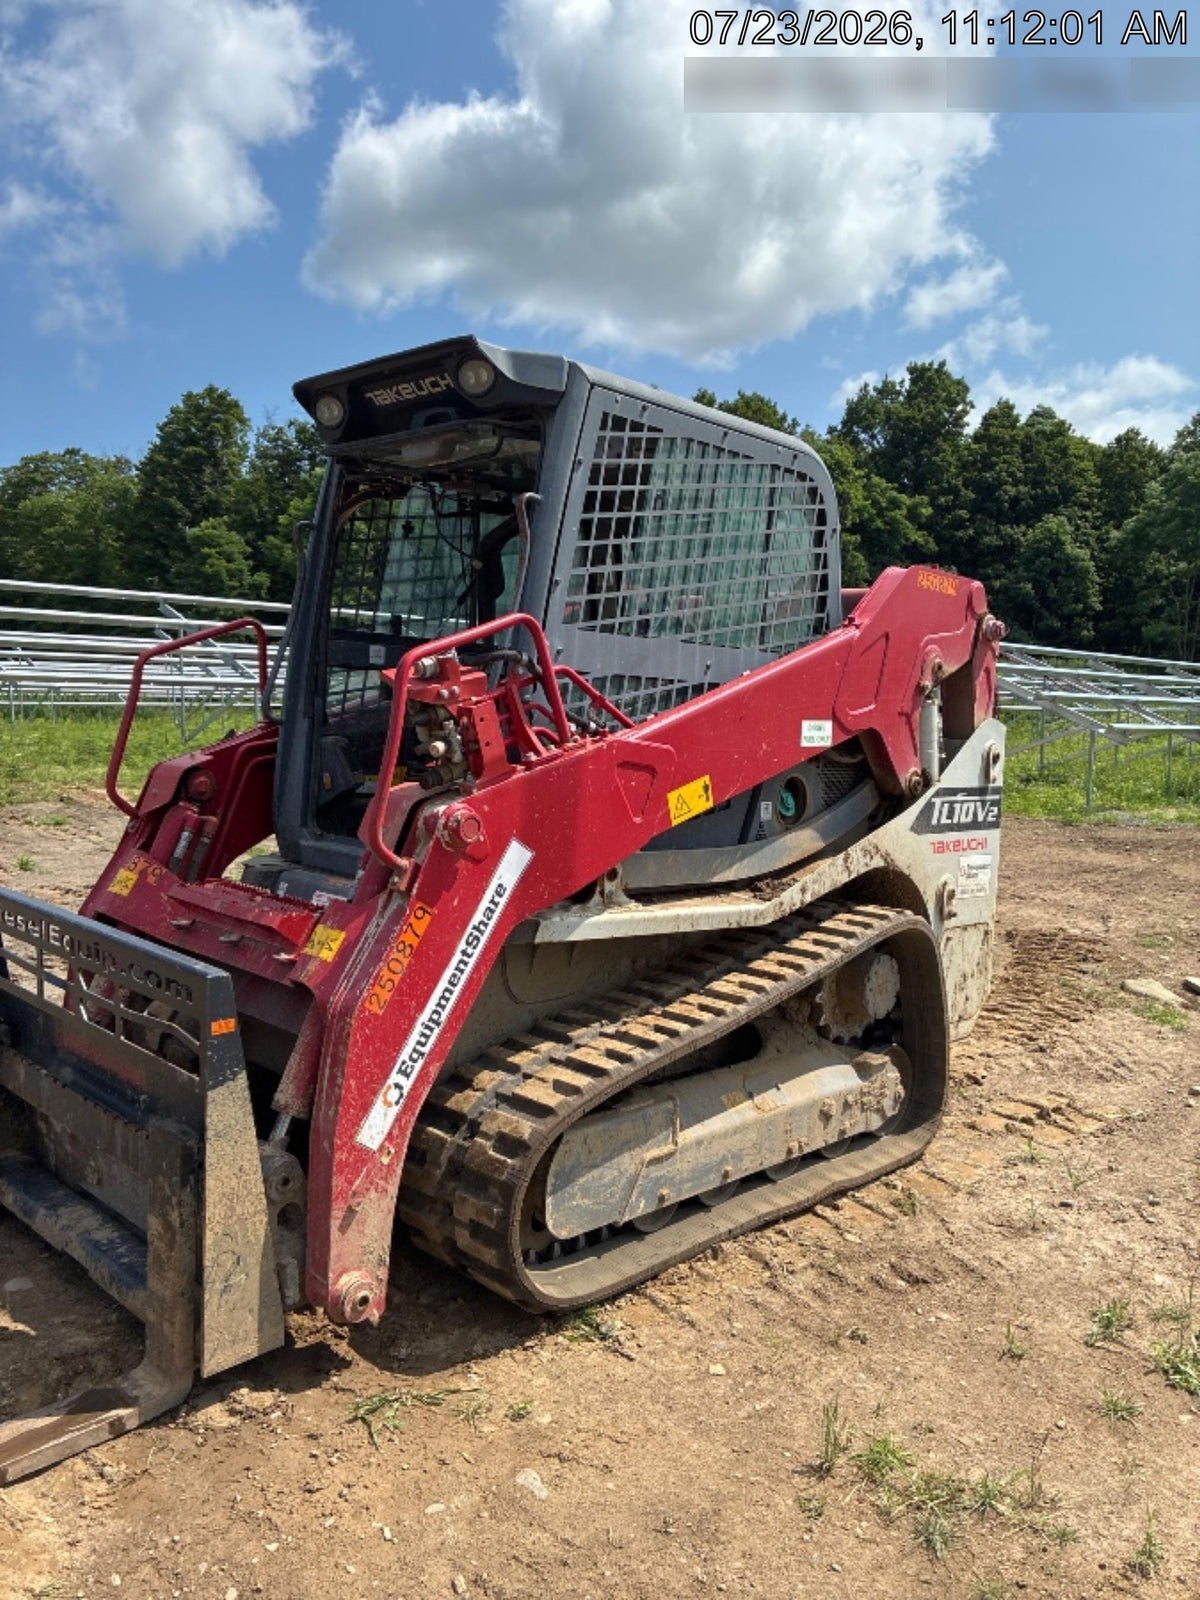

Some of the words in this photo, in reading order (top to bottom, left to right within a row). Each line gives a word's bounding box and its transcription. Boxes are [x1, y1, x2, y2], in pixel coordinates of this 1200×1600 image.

[364, 373, 455, 406] TAKEUCH
[930, 837, 988, 854] TAKEUCHI
[2, 909, 193, 1005] eselEquip.com
[368, 902, 433, 1012] 250879
[397, 883, 507, 1078] EquipmentShare
